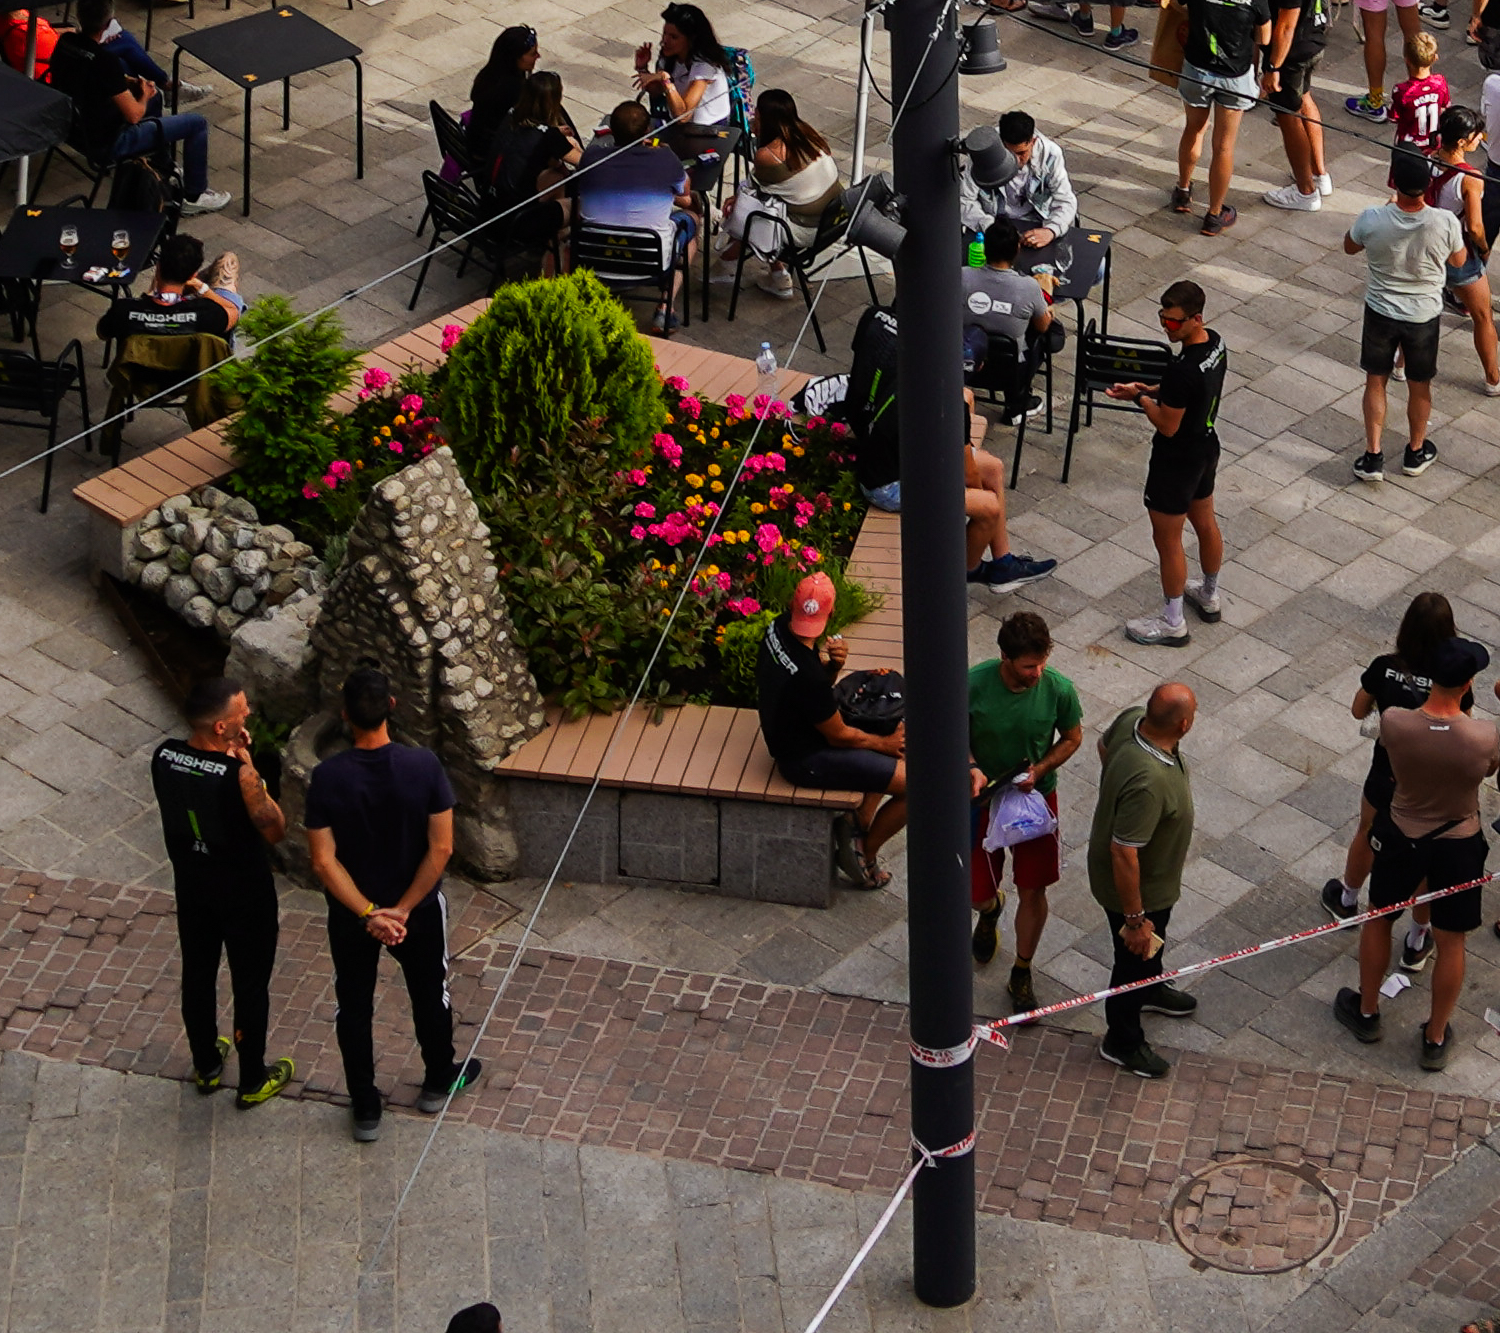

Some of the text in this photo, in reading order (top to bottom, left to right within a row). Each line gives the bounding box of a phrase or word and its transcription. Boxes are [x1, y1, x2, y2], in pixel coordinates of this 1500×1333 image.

[1414, 103, 1440, 136] 11
[129, 311, 197, 323] FINISHER
[160, 748, 228, 776] FINISHER
